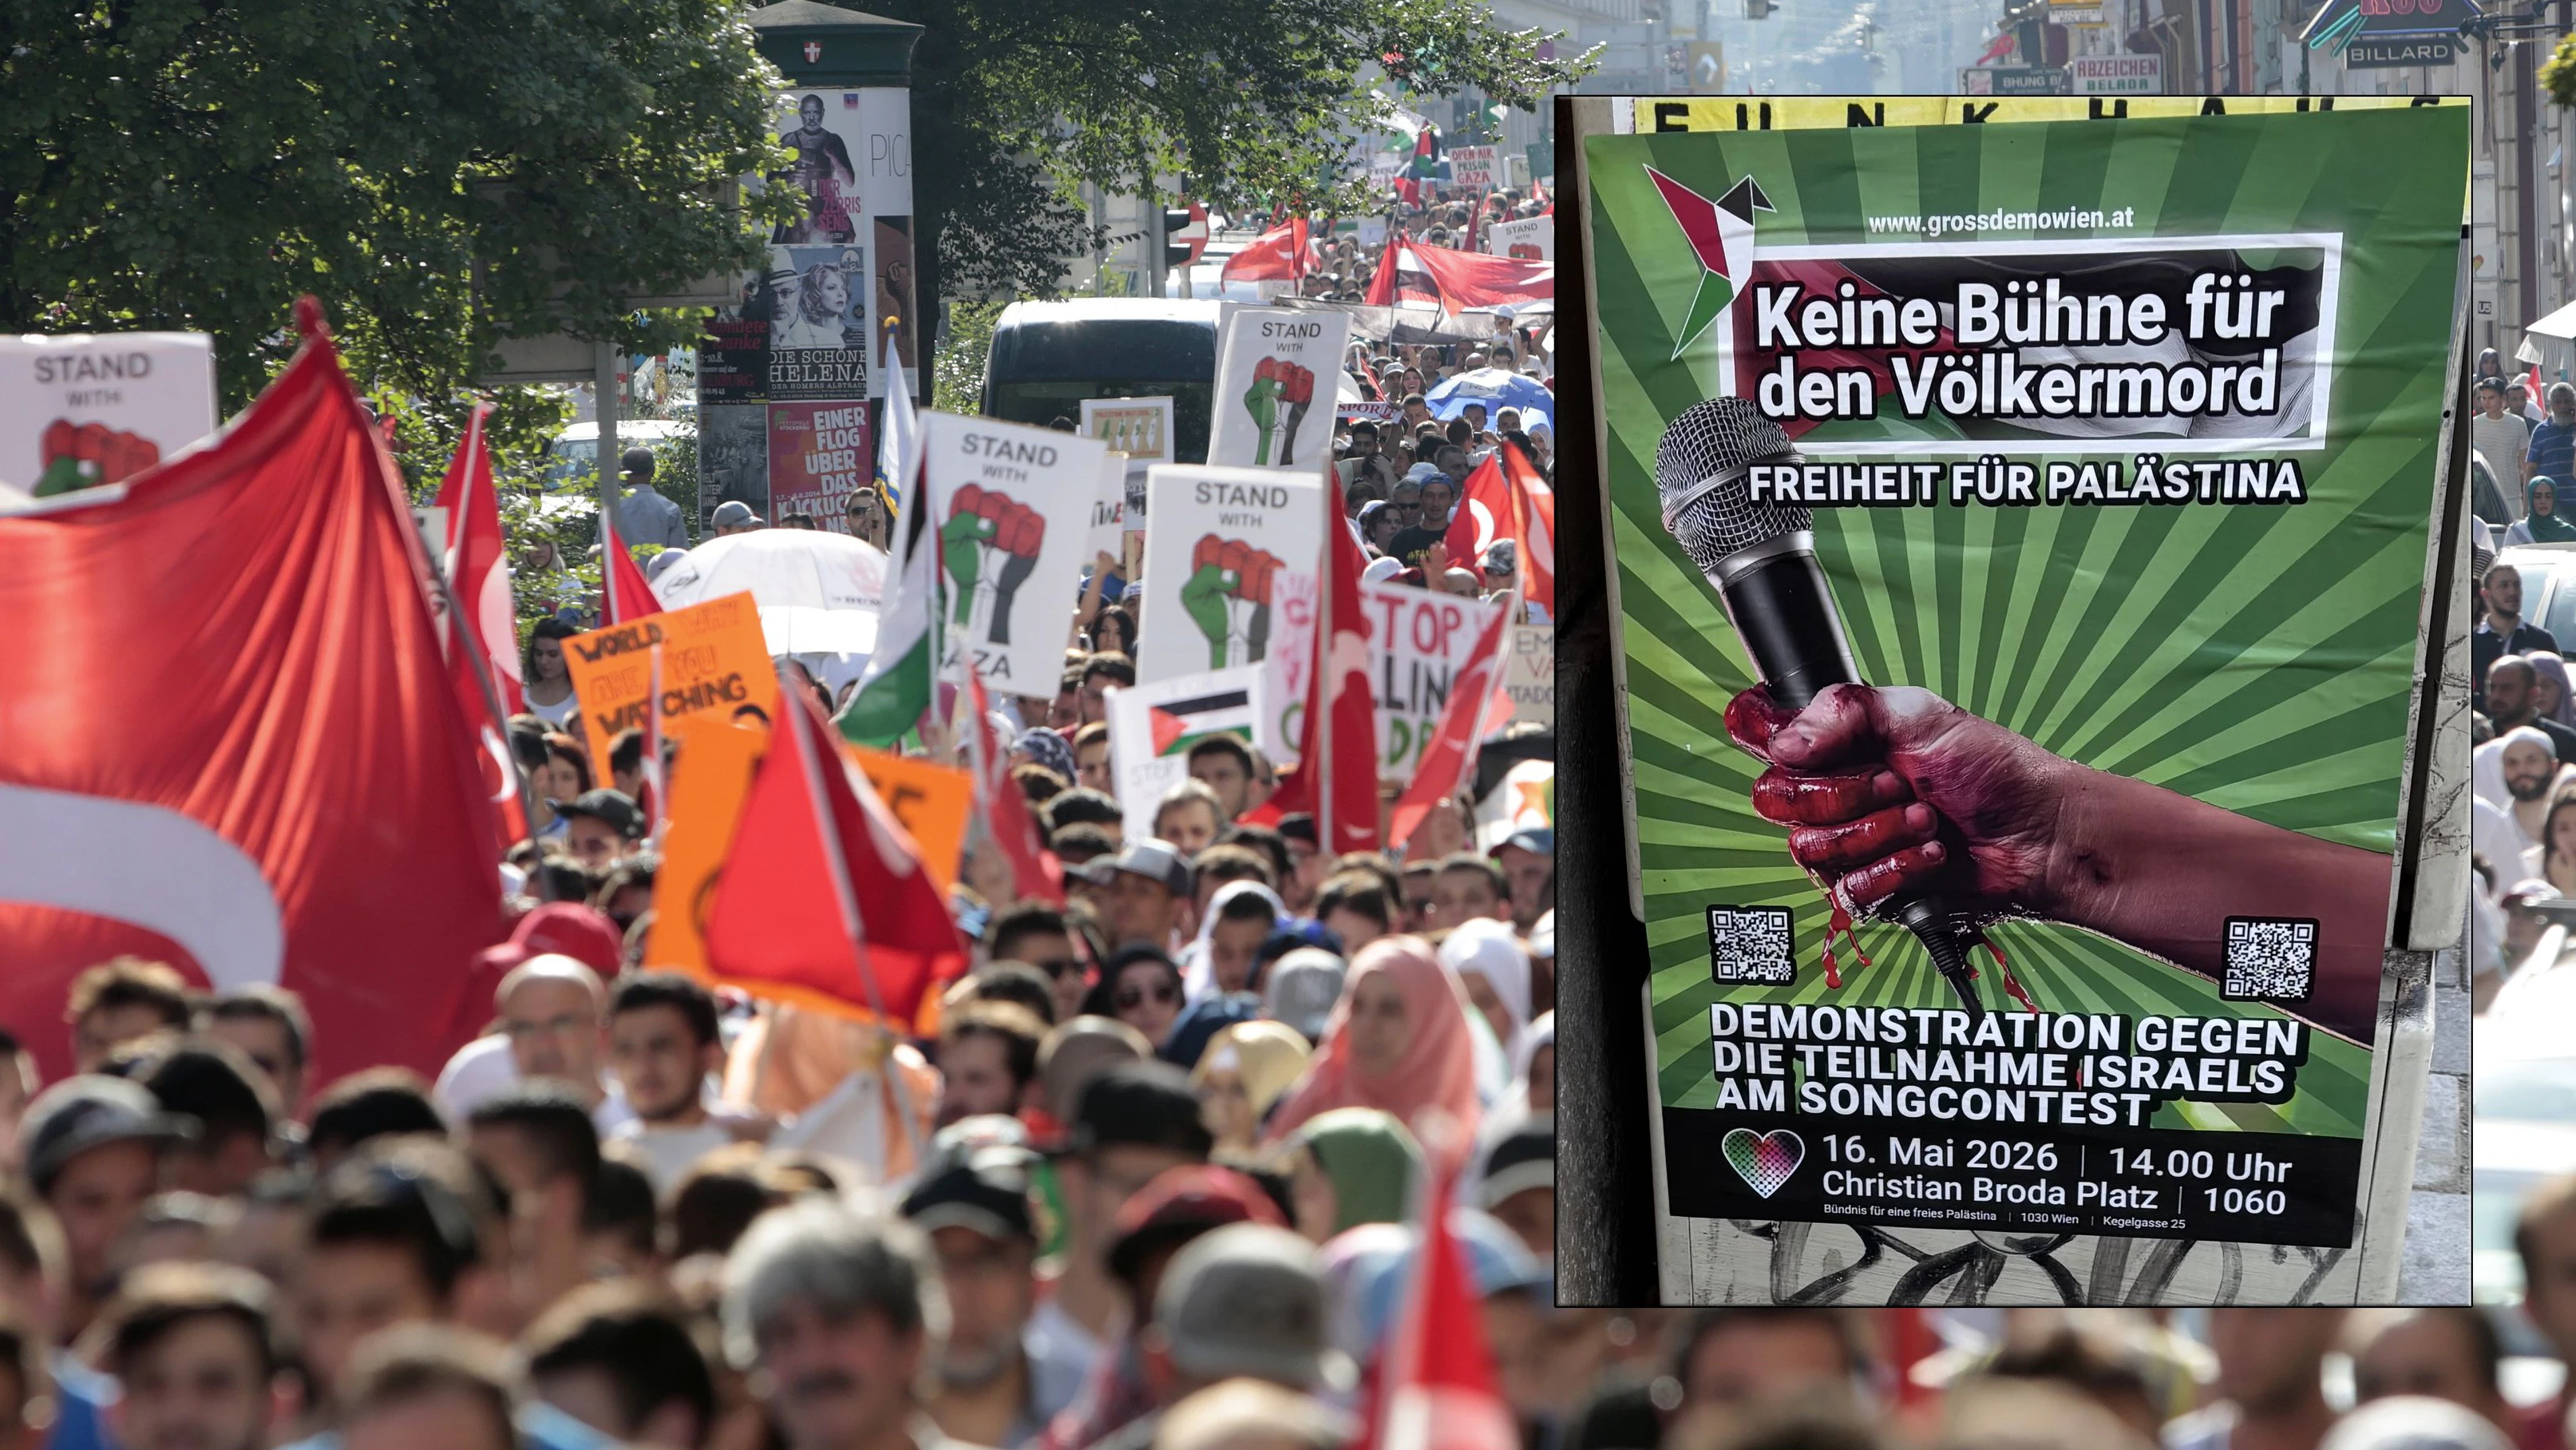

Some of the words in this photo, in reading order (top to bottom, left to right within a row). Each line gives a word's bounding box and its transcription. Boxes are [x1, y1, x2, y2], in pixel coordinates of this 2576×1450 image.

[2351, 46, 2447, 61] BILLARD
[2077, 59, 2157, 77] ABZEICHEN
[2087, 78, 2148, 91] BELADA
[1457, 160, 1490, 172] PRISON
[1457, 170, 1490, 184] GAZA
[1506, 223, 1537, 234] STAND
[1869, 206, 2134, 236] www.grossdemowien.at
[1756, 283, 1937, 347] Keine
[1958, 278, 2166, 345] Bühne
[2186, 273, 2285, 339] für
[2479, 302, 2491, 315] U5
[1261, 322, 1321, 338] STAND
[770, 351, 795, 363] DIE
[801, 347, 866, 363] SCHÖNE
[1276, 343, 1303, 352] WITH
[34, 352, 152, 383] STAND
[770, 364, 866, 382] HELENA
[1759, 356, 1874, 417] den
[1891, 348, 2278, 415] Völkermord
[65, 389, 122, 406] WITH
[813, 406, 866, 431] EINER
[816, 427, 861, 451] FLOG
[961, 433, 1058, 467] STAND
[805, 449, 857, 474] ÜBER
[983, 465, 1028, 483] WITH
[821, 471, 858, 496] DAS
[1749, 466, 1940, 501] FREIHEIT
[1953, 457, 2035, 500] FÜR
[2048, 456, 2301, 500] PALÄSTINA
[1195, 481, 1288, 509] STAND
[1218, 513, 1263, 527] WITH
[664, 644, 718, 683] YOU
[1711, 1004, 2120, 1050] DEMONSTRATION
[2136, 1016, 2299, 1056] GEGEN
[1715, 1041, 1785, 1076] DIE
[1795, 1044, 2068, 1086] TEILNAHME
[2083, 1055, 2285, 1094] ISRAELS
[1716, 1078, 1785, 1111] AM
[1800, 1081, 2151, 1127] SONGCONTEST
[1822, 1135, 1875, 1163] 16.
[1889, 1137, 1953, 1167] Mai
[1966, 1140, 2058, 1171] 2026
[2109, 1147, 2214, 1179] 14.00
[2226, 1152, 2293, 1183] Uhr
[1822, 1170, 1961, 1201] Christian
[1973, 1177, 2066, 1206] Broda
[2077, 1182, 2158, 1209] Platz
[2204, 1187, 2285, 1214] 1060
[1824, 1204, 1866, 1215] Bündnis
[1870, 1206, 1885, 1216] für
[1888, 1206, 1910, 1217] eine
[1913, 1207, 1943, 1218] freies
[1946, 1210, 1996, 1221] Palästina
[2021, 1213, 2048, 1223] 1030
[2052, 1214, 2079, 1224] Wien
[2103, 1216, 2168, 1230] Kegelgasse
[2170, 1219, 2186, 1229] 25
